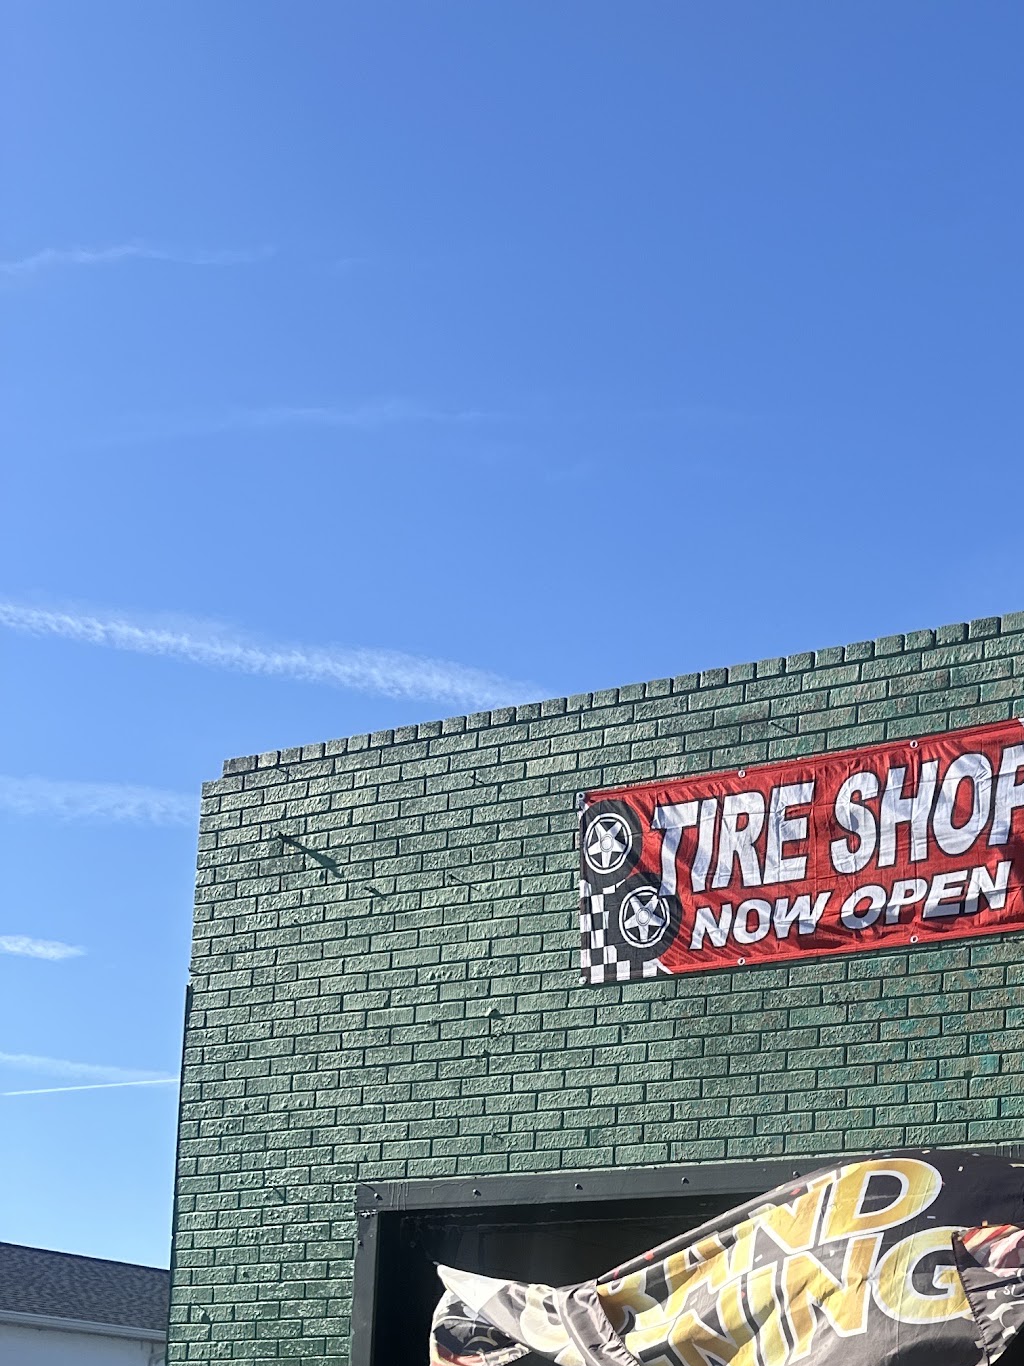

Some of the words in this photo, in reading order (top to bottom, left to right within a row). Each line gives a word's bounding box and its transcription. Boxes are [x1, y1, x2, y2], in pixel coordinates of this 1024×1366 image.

[652, 780, 816, 898] TIRE
[689, 889, 832, 951] NOW
[840, 861, 1012, 930] OPEN
